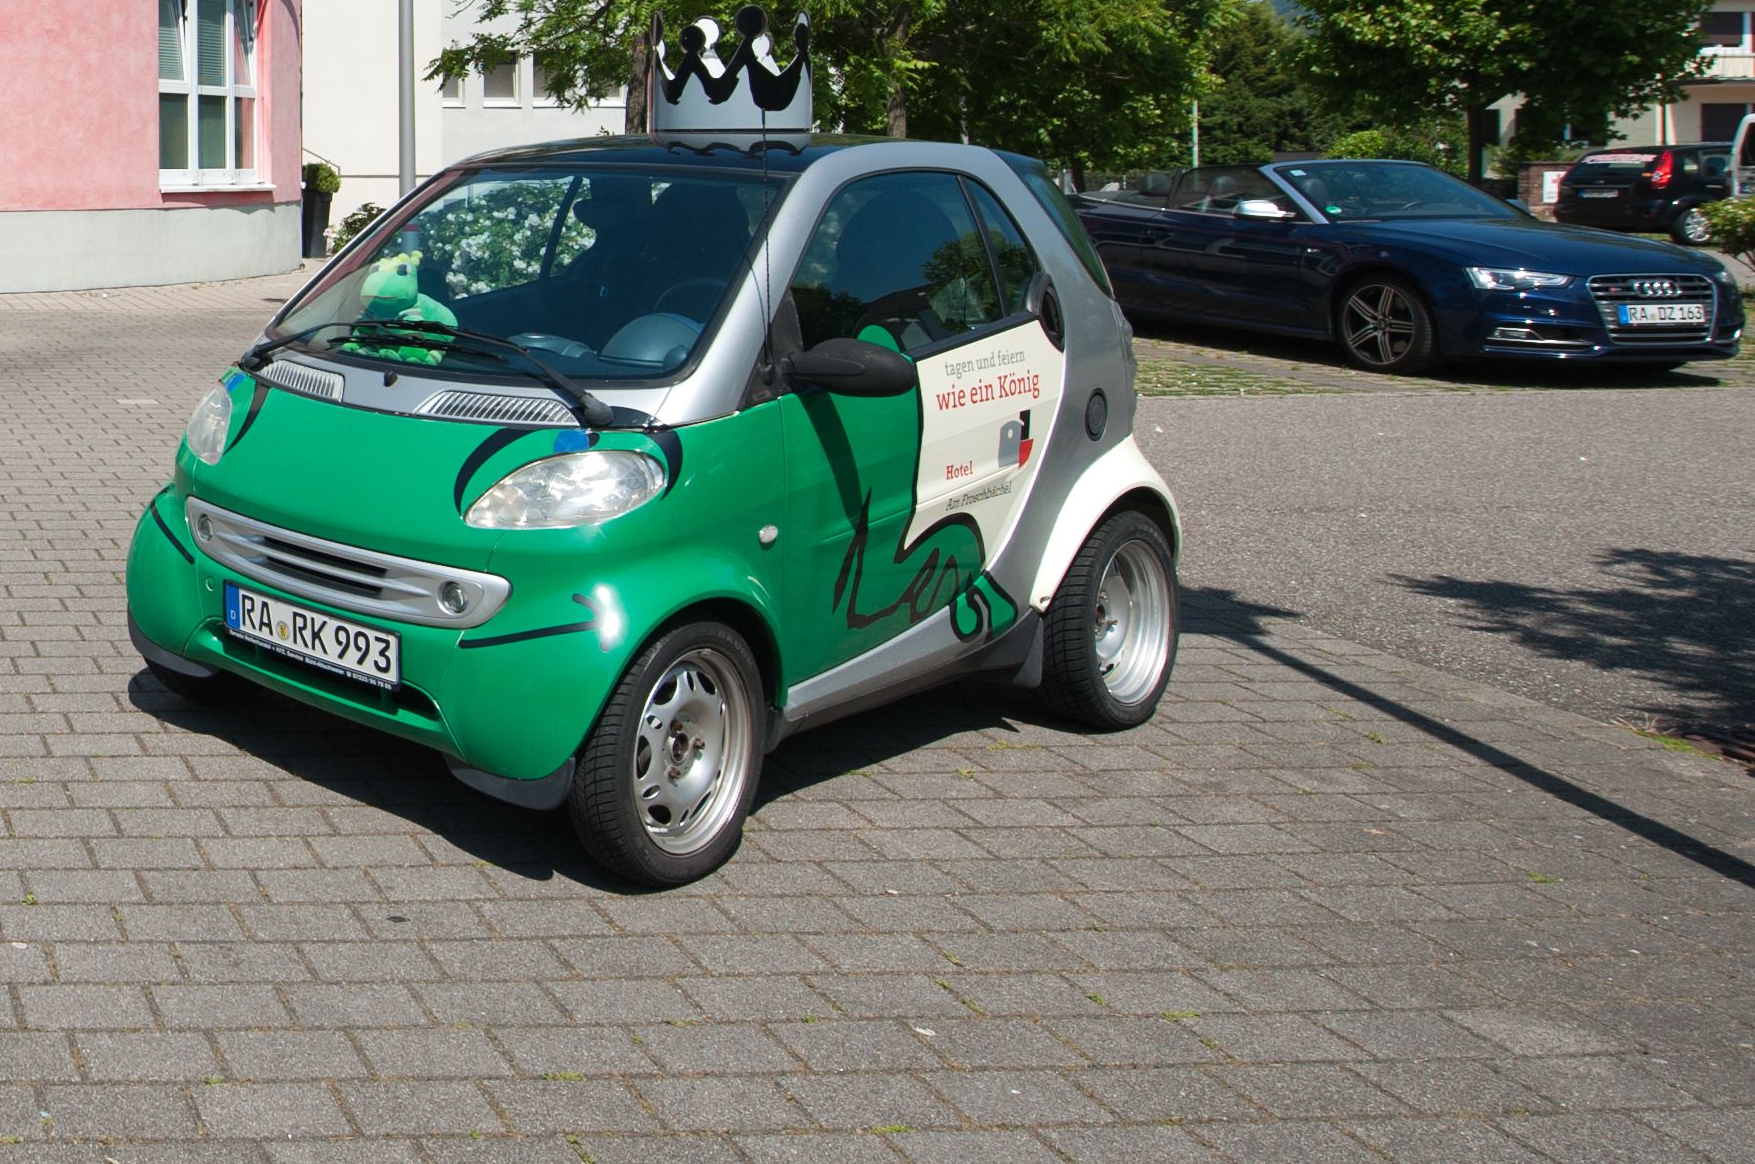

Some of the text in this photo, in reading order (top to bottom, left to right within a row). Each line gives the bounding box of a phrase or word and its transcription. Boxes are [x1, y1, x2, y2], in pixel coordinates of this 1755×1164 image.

[1628, 306, 1702, 321] RA DZ 163
[945, 349, 1025, 379] tagen und feiern
[936, 369, 1040, 411] wie ein König
[946, 460, 973, 480] Hotel
[230, 610, 237, 620] D
[241, 593, 274, 636] RA
[292, 611, 329, 655] RK
[334, 625, 392, 674] 993
